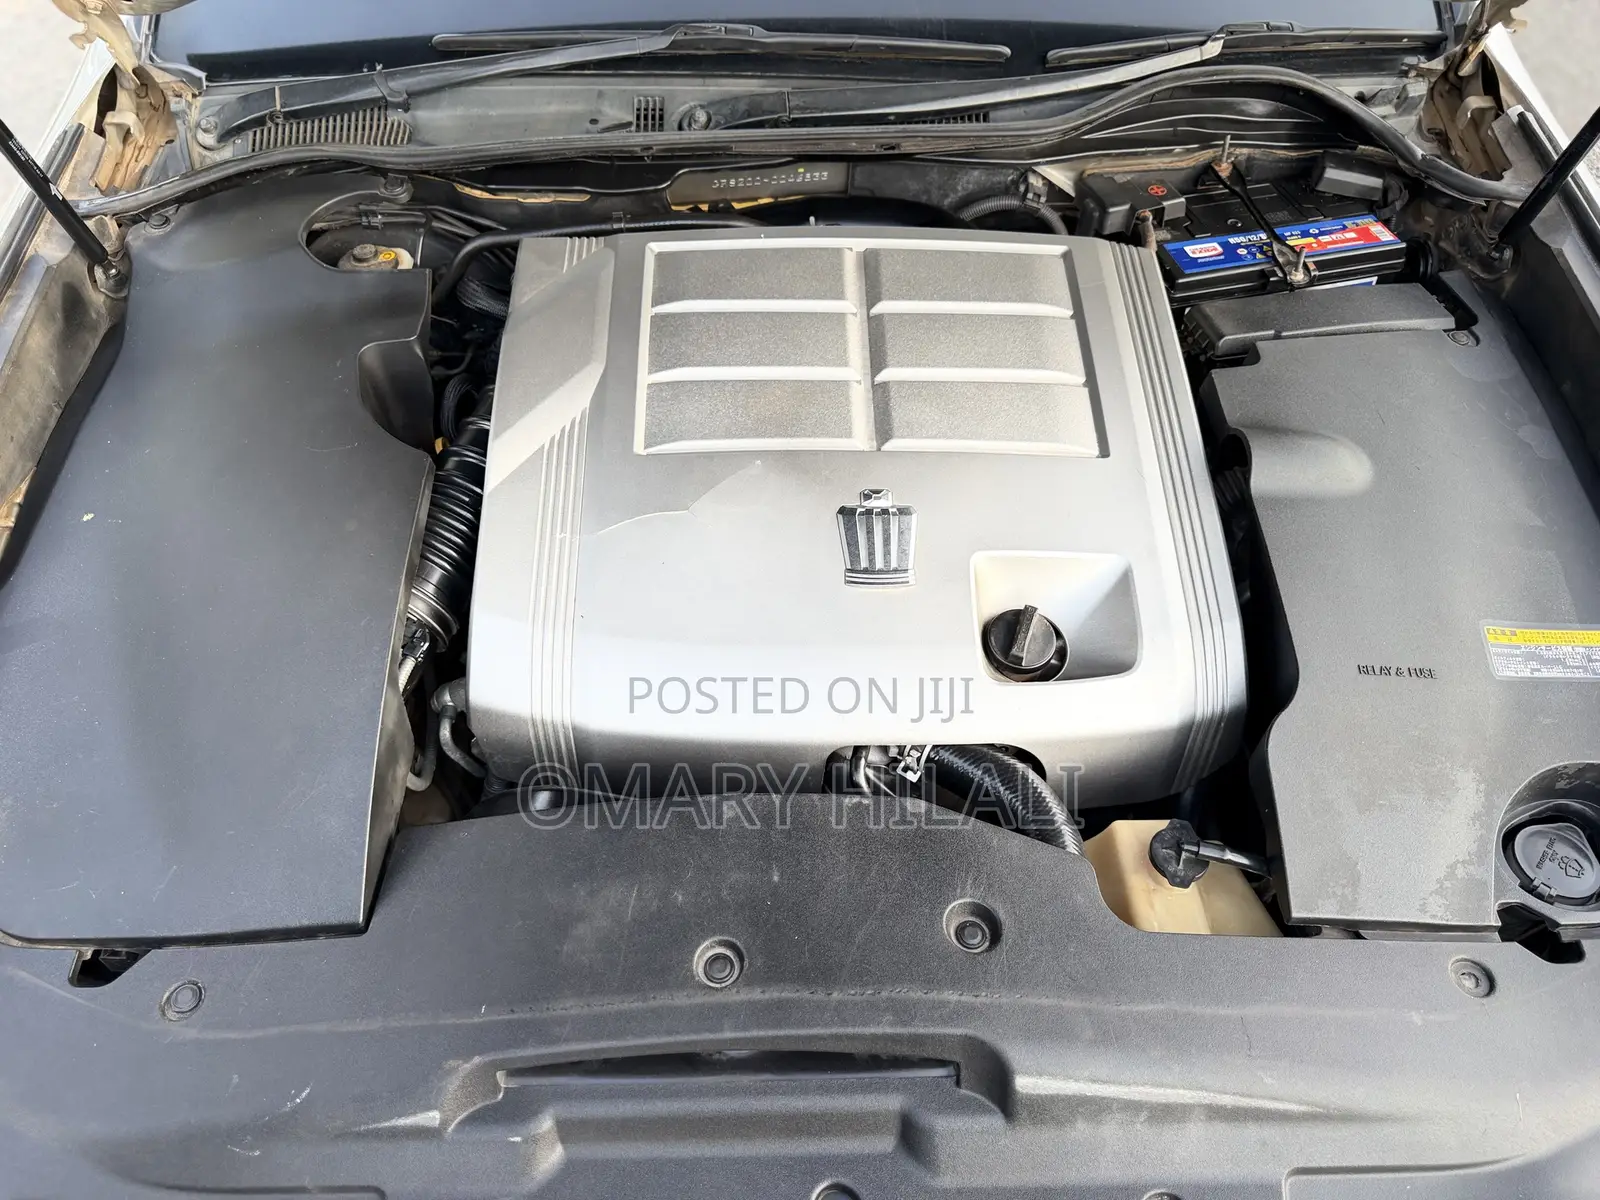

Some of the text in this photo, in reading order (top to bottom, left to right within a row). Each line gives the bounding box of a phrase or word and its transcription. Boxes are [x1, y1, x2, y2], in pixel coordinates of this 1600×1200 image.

[1357, 664, 1439, 680] RELAY & FUSE
